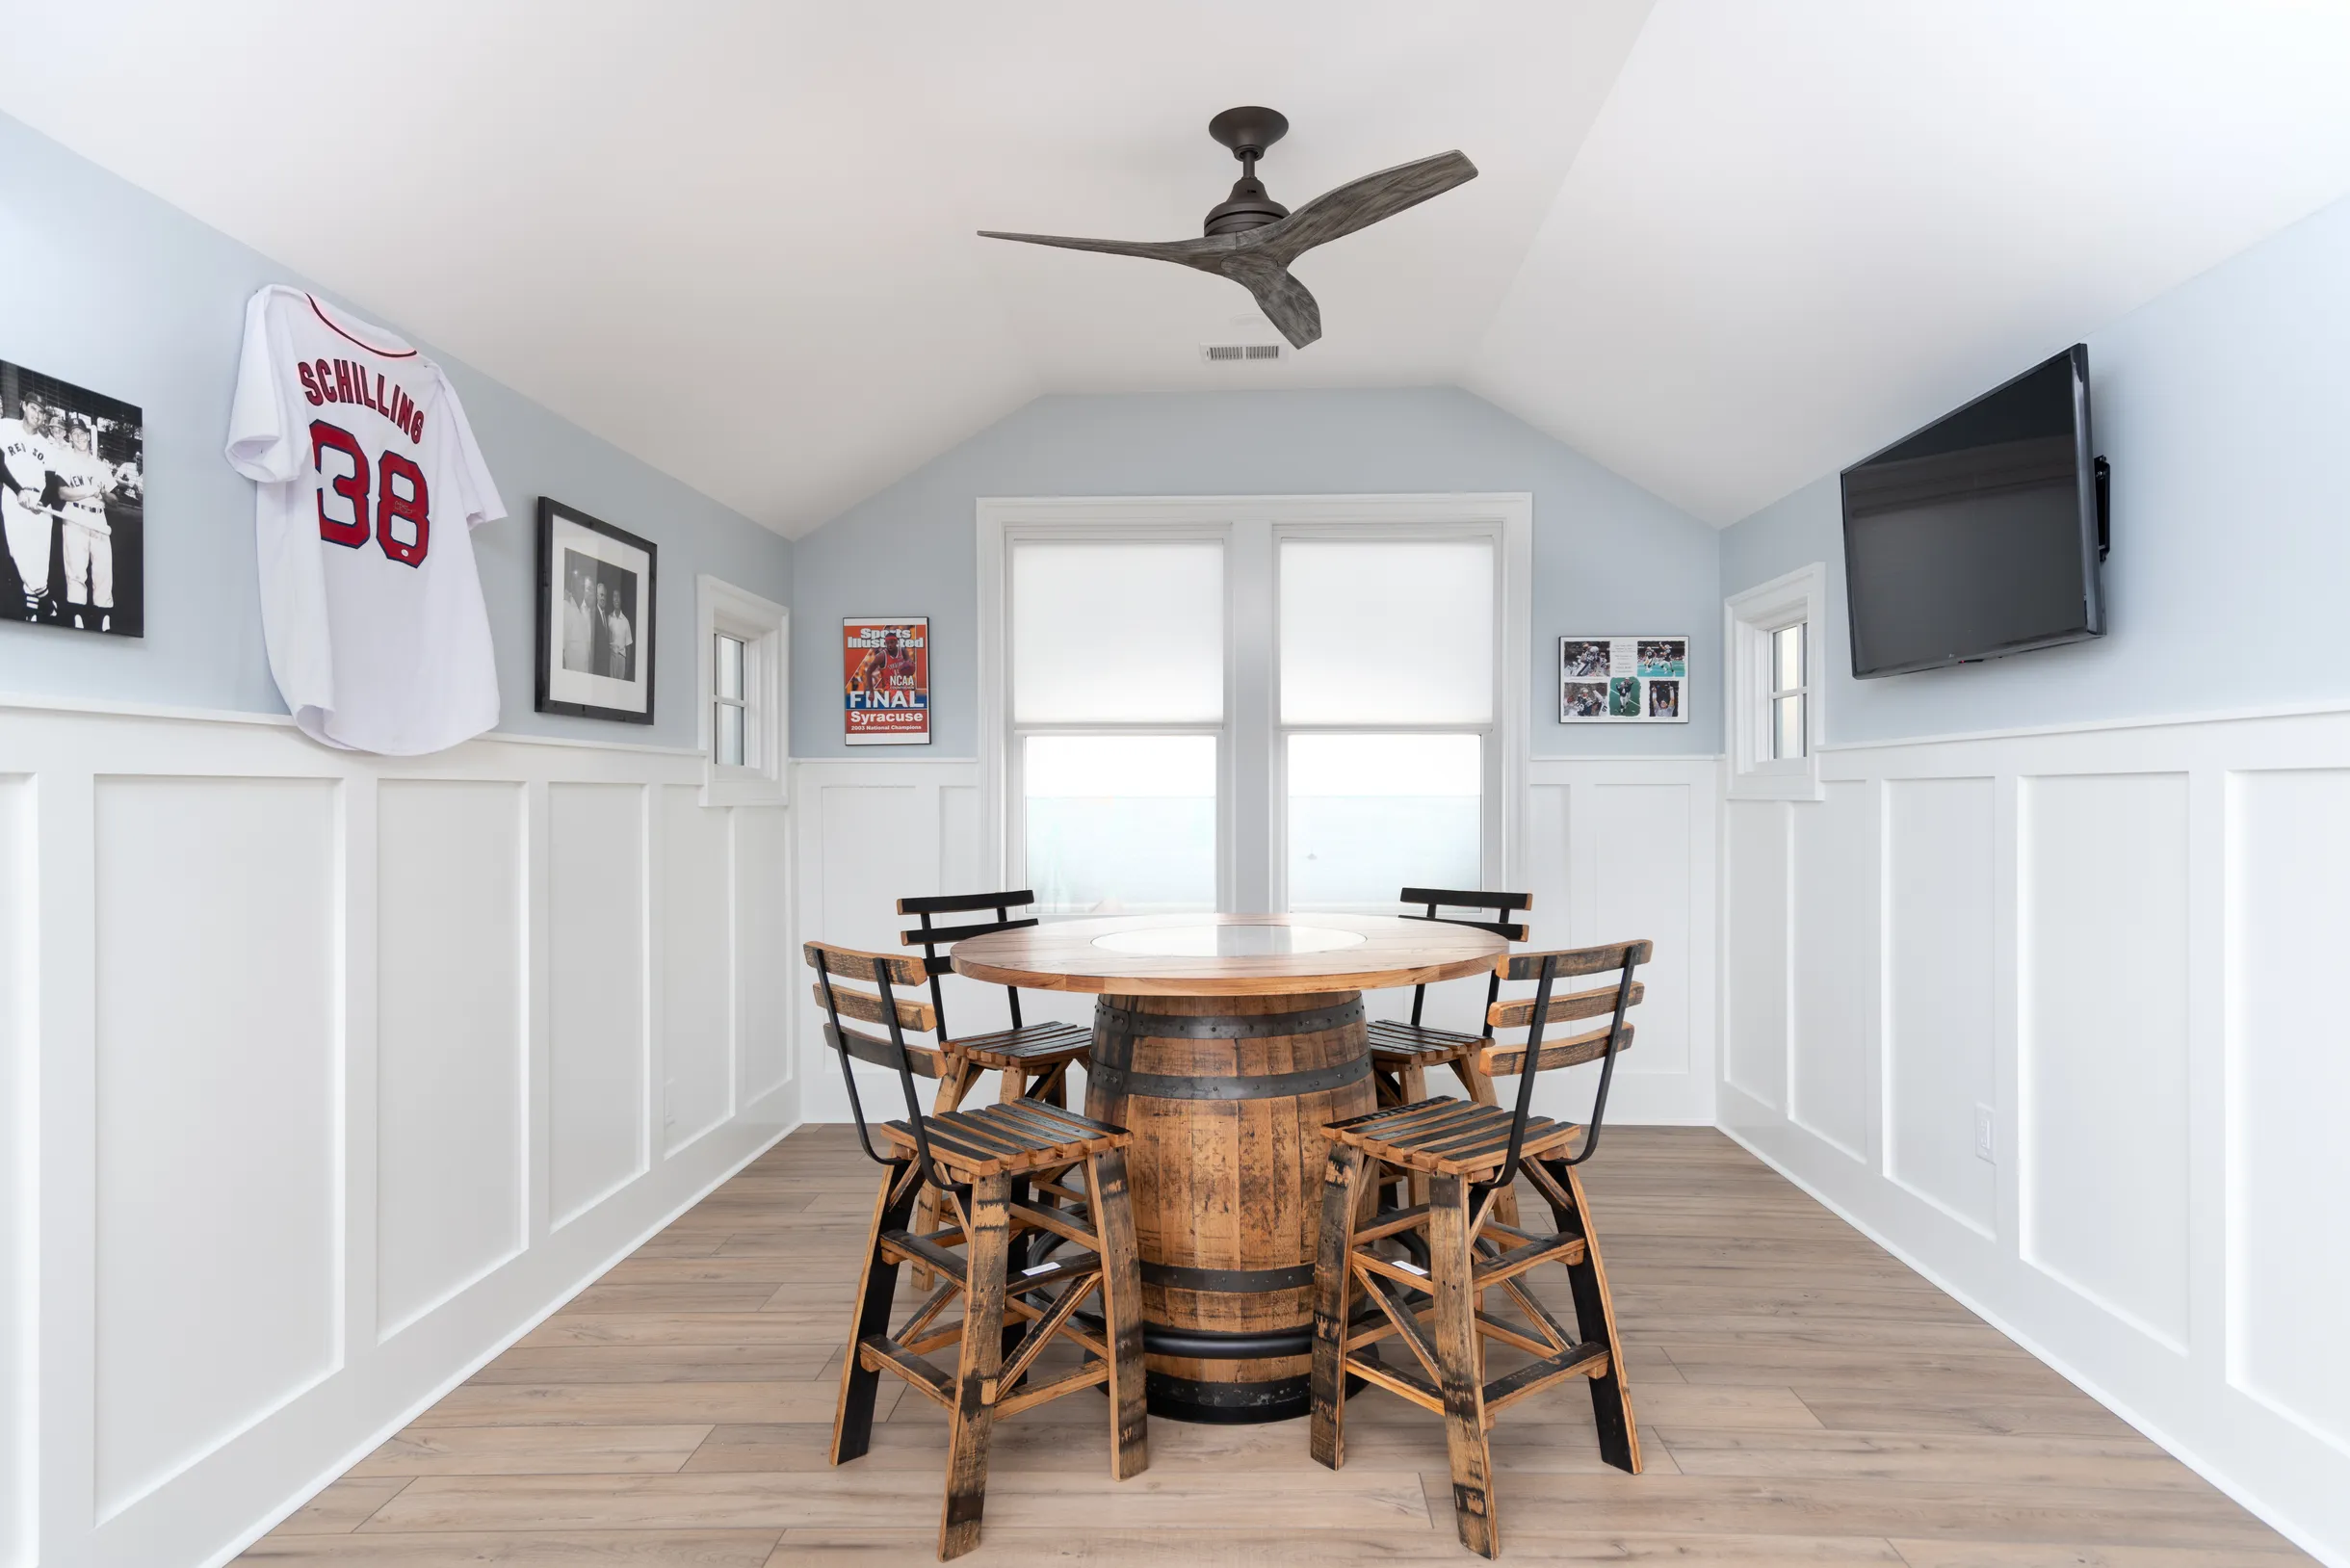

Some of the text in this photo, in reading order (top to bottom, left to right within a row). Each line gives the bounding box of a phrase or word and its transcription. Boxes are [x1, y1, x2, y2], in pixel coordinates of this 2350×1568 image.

[298, 358, 425, 444] SCHILLING
[309, 418, 430, 569] 38
[848, 636, 924, 648] Illustted
[890, 675, 915, 686] NCAA
[849, 691, 925, 708] FINAL
[850, 711, 924, 725] Syracuse
